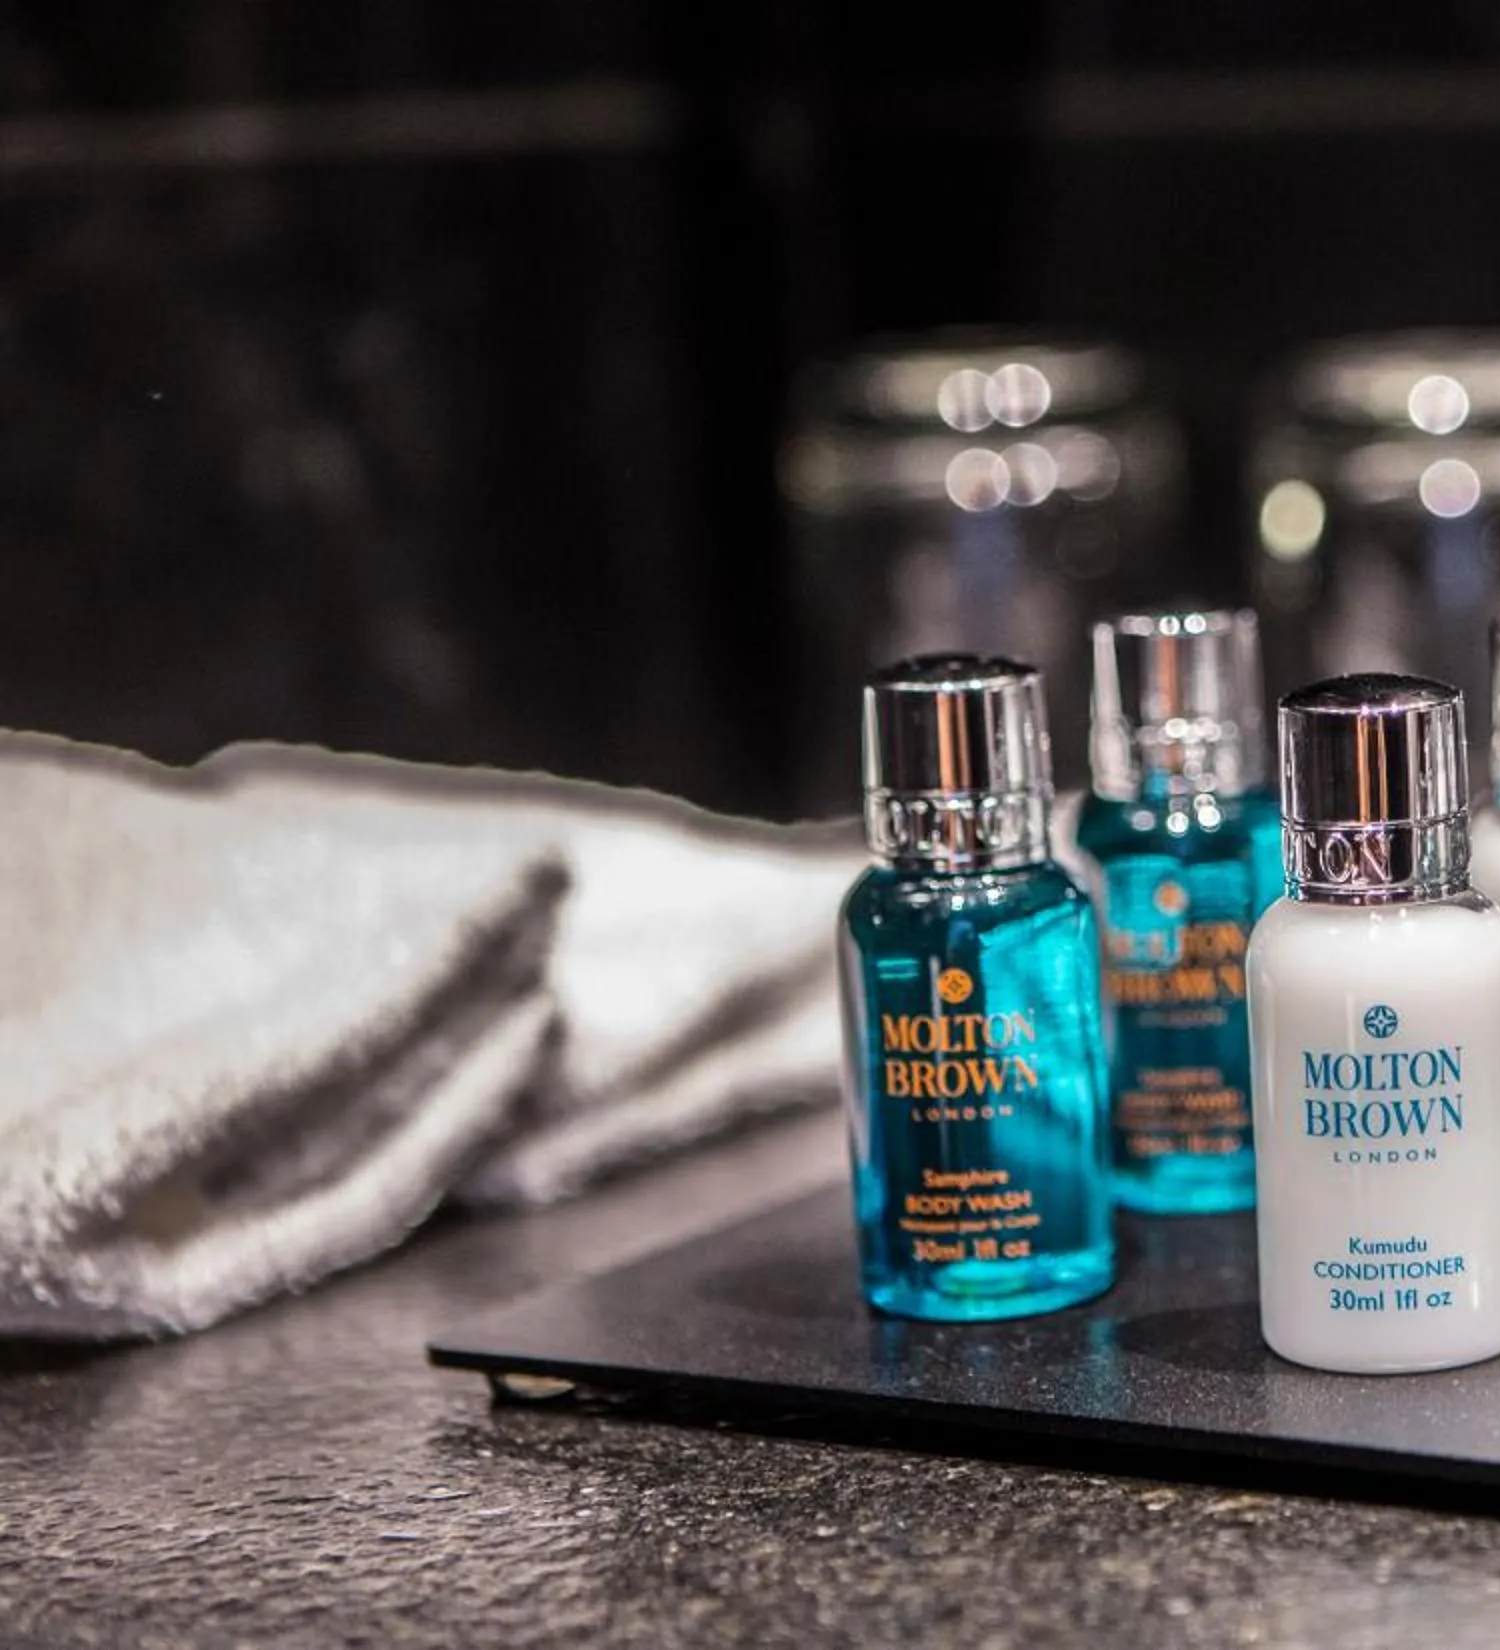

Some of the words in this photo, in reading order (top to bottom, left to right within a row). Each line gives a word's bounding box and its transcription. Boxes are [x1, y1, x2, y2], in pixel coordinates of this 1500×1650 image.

[882, 1007, 1036, 1053] MOLTON
[884, 1053, 1038, 1098] BROWN
[1303, 1046, 1462, 1091] MOLTON
[1305, 1094, 1463, 1138] BROWN
[1333, 1148, 1437, 1164] LONDON
[905, 1194, 960, 1215] BODY
[967, 1189, 1032, 1212] WASH
[1349, 1236, 1427, 1254] Kumudu
[1313, 1256, 1464, 1281] CONDITIONER
[1330, 1289, 1384, 1311] 30ml
[1426, 1291, 1453, 1307] oz
